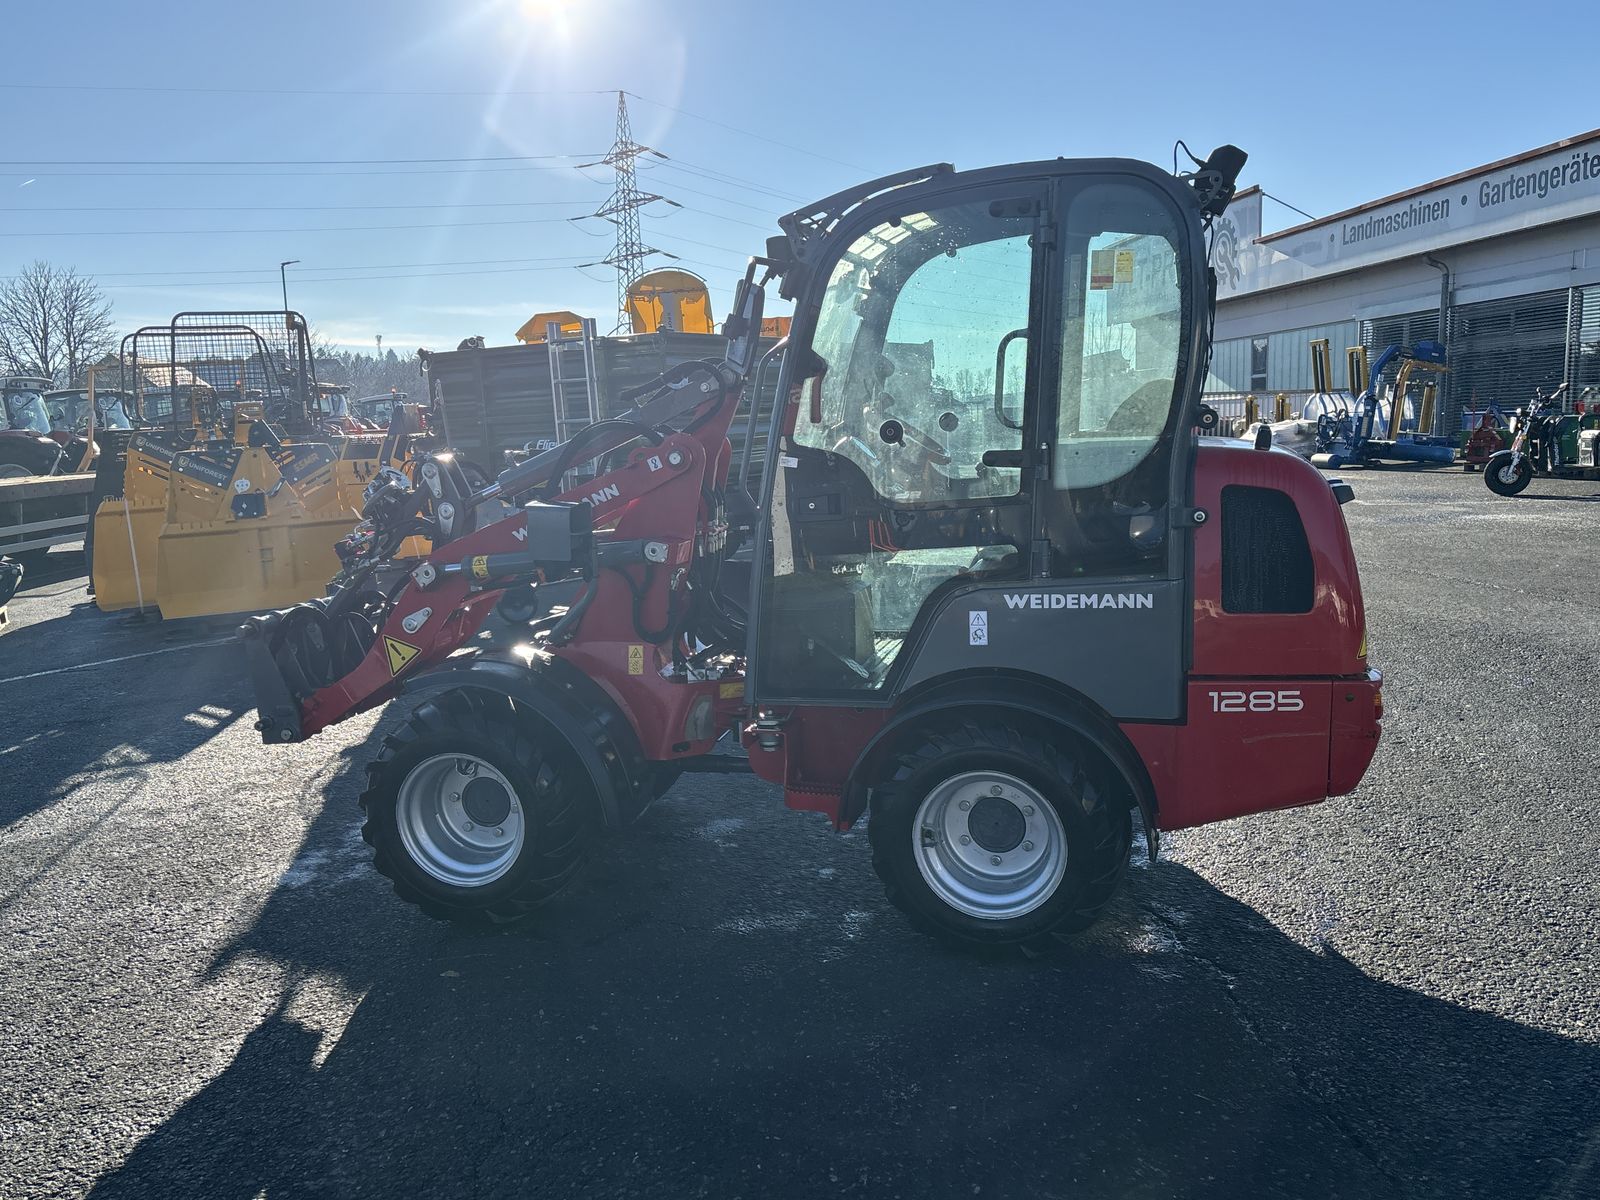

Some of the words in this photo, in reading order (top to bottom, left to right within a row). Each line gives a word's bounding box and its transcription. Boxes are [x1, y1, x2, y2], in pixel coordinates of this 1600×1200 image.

[1342, 198, 1450, 246] Landmaschinen
[1479, 152, 1600, 208] Gartengeräte
[188, 462, 228, 481] UNIFOREST
[1003, 593, 1154, 609] WEIDEMANN
[1208, 690, 1305, 712] 1285
